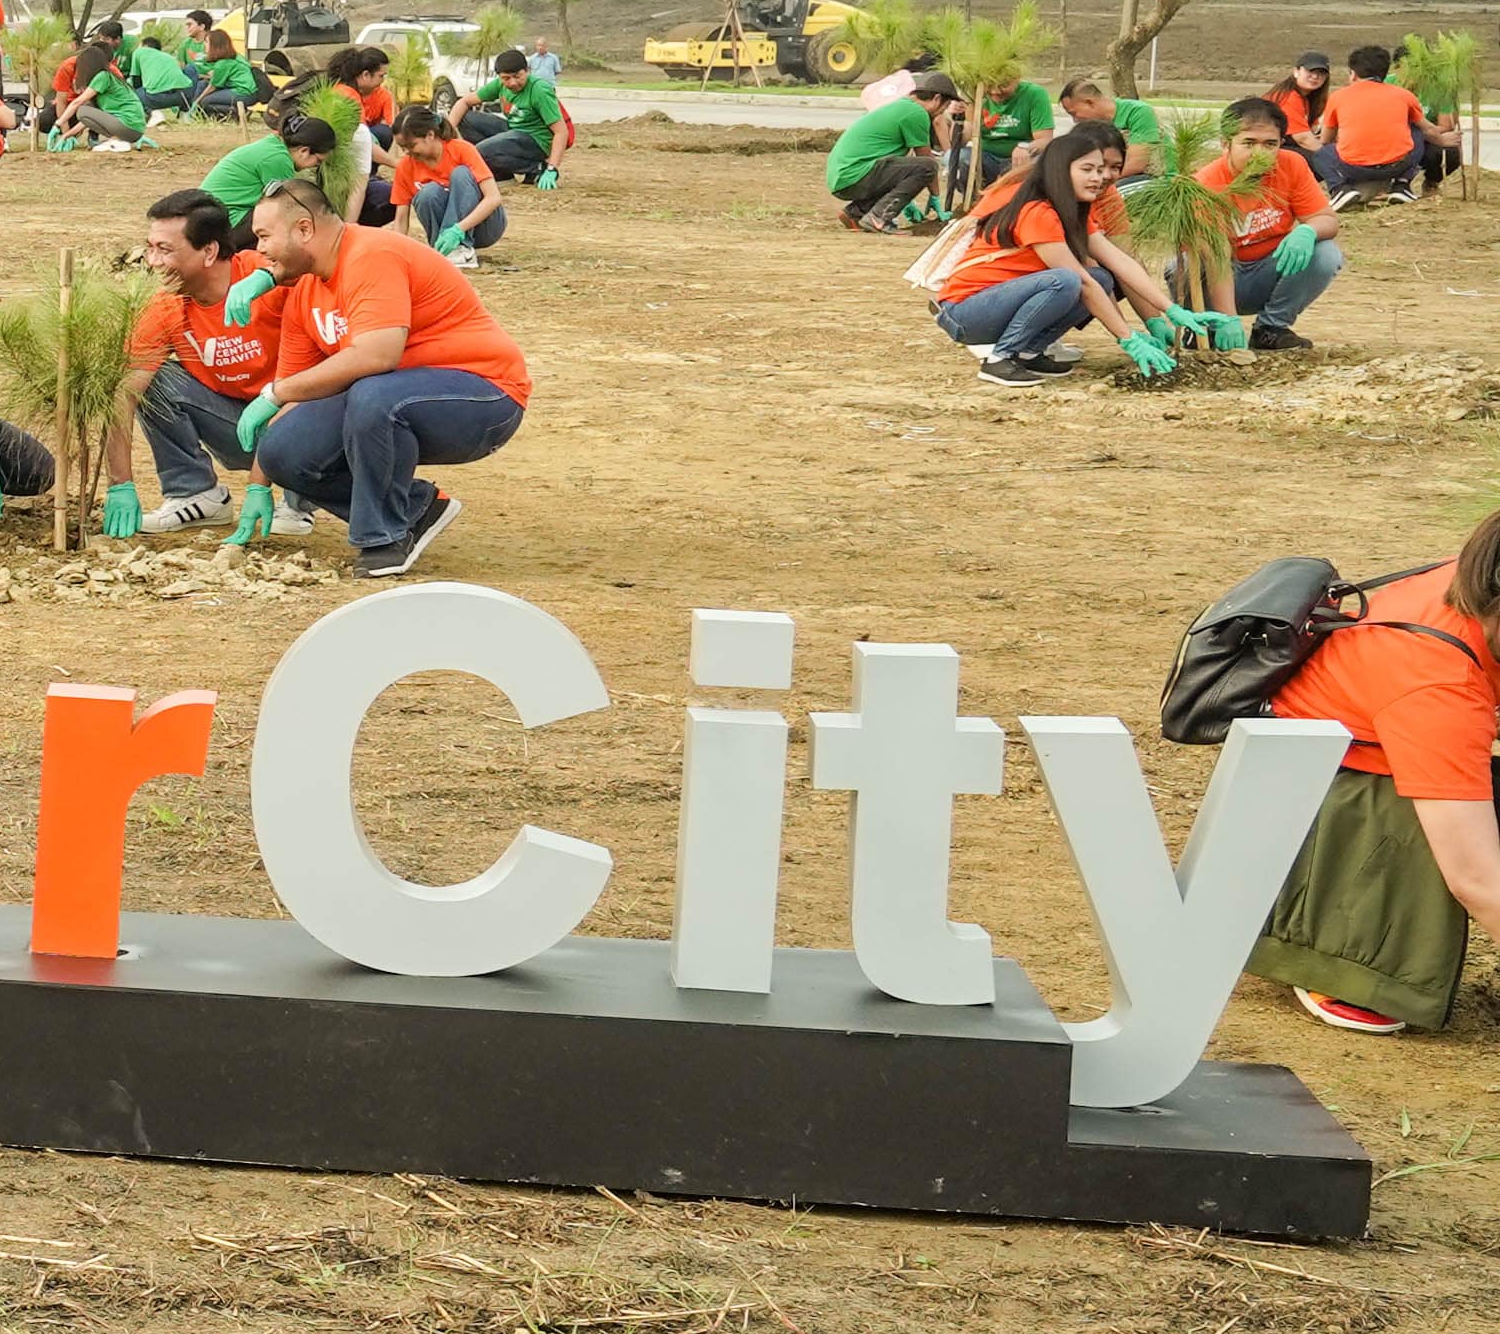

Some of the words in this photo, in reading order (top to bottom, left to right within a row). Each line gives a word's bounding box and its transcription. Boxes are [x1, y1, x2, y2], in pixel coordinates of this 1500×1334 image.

[216, 339, 258, 358] CENTER
[217, 335, 242, 349] NEW
[215, 347, 262, 367] GRAVITY
